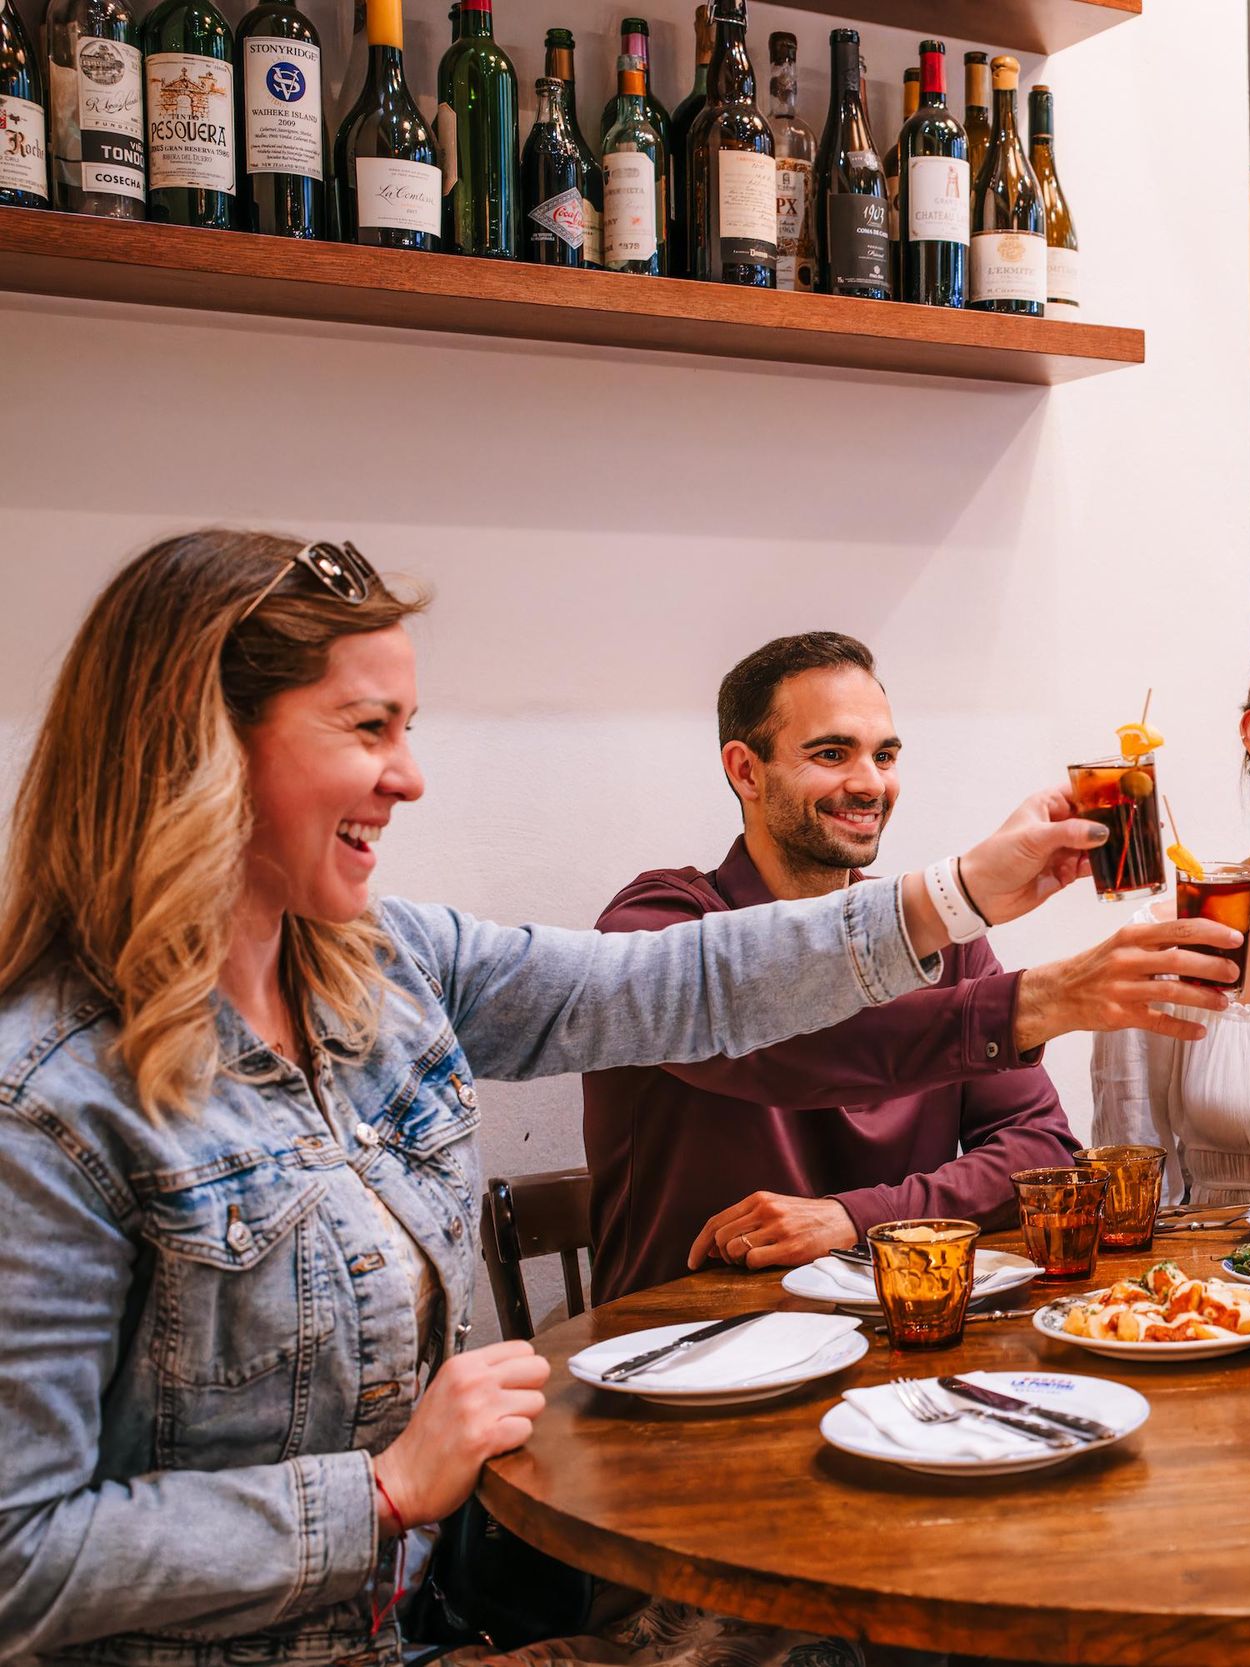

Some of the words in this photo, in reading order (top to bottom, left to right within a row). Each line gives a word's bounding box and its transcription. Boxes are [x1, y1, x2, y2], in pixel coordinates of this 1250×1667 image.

[250, 44, 316, 61] STONYRIDGE
[252, 109, 290, 117] WAIHEKE
[291, 111, 318, 124] ISLAND
[278, 119, 296, 127] 2009
[151, 120, 227, 147] PESQUERA
[184, 146, 215, 155] RESERVA
[95, 173, 141, 189] COSECHA
[776, 197, 798, 215] PX
